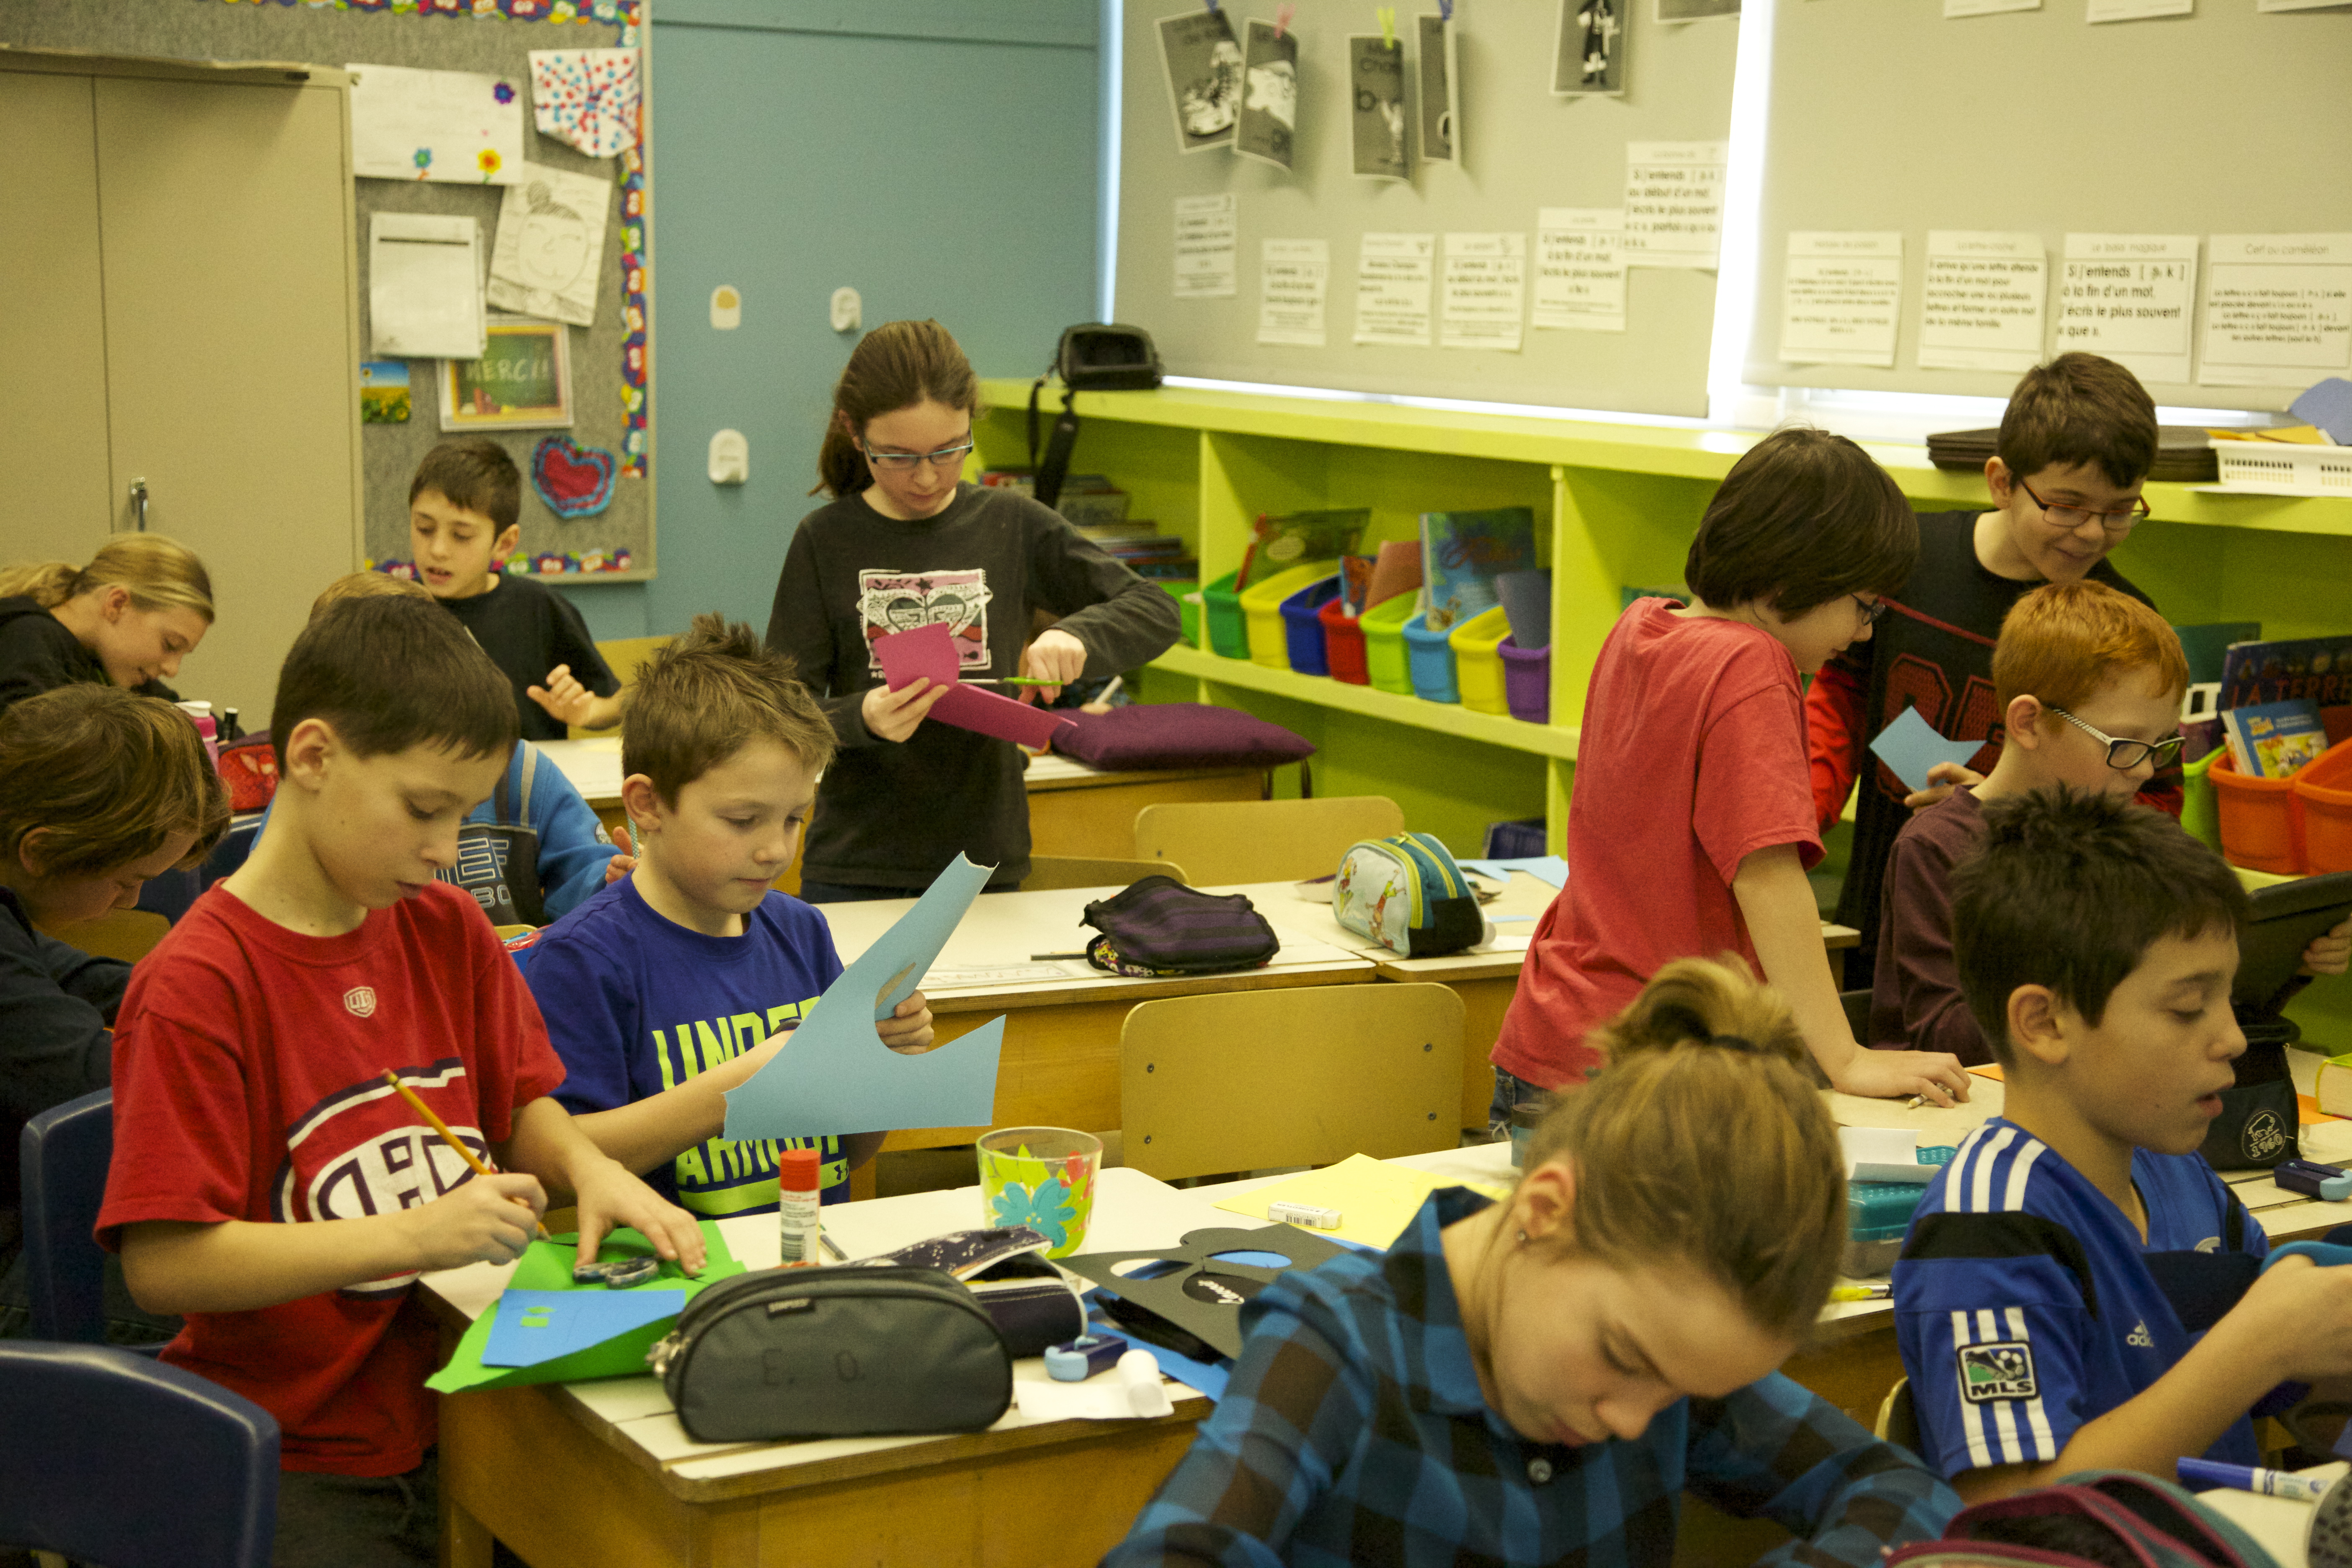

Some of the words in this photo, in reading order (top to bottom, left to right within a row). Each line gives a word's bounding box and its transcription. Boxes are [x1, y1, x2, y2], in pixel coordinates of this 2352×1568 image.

[652, 995, 826, 1092] UND
[2251, 1133, 2283, 1158] 1960
[1971, 1380, 2033, 1397] MLS
